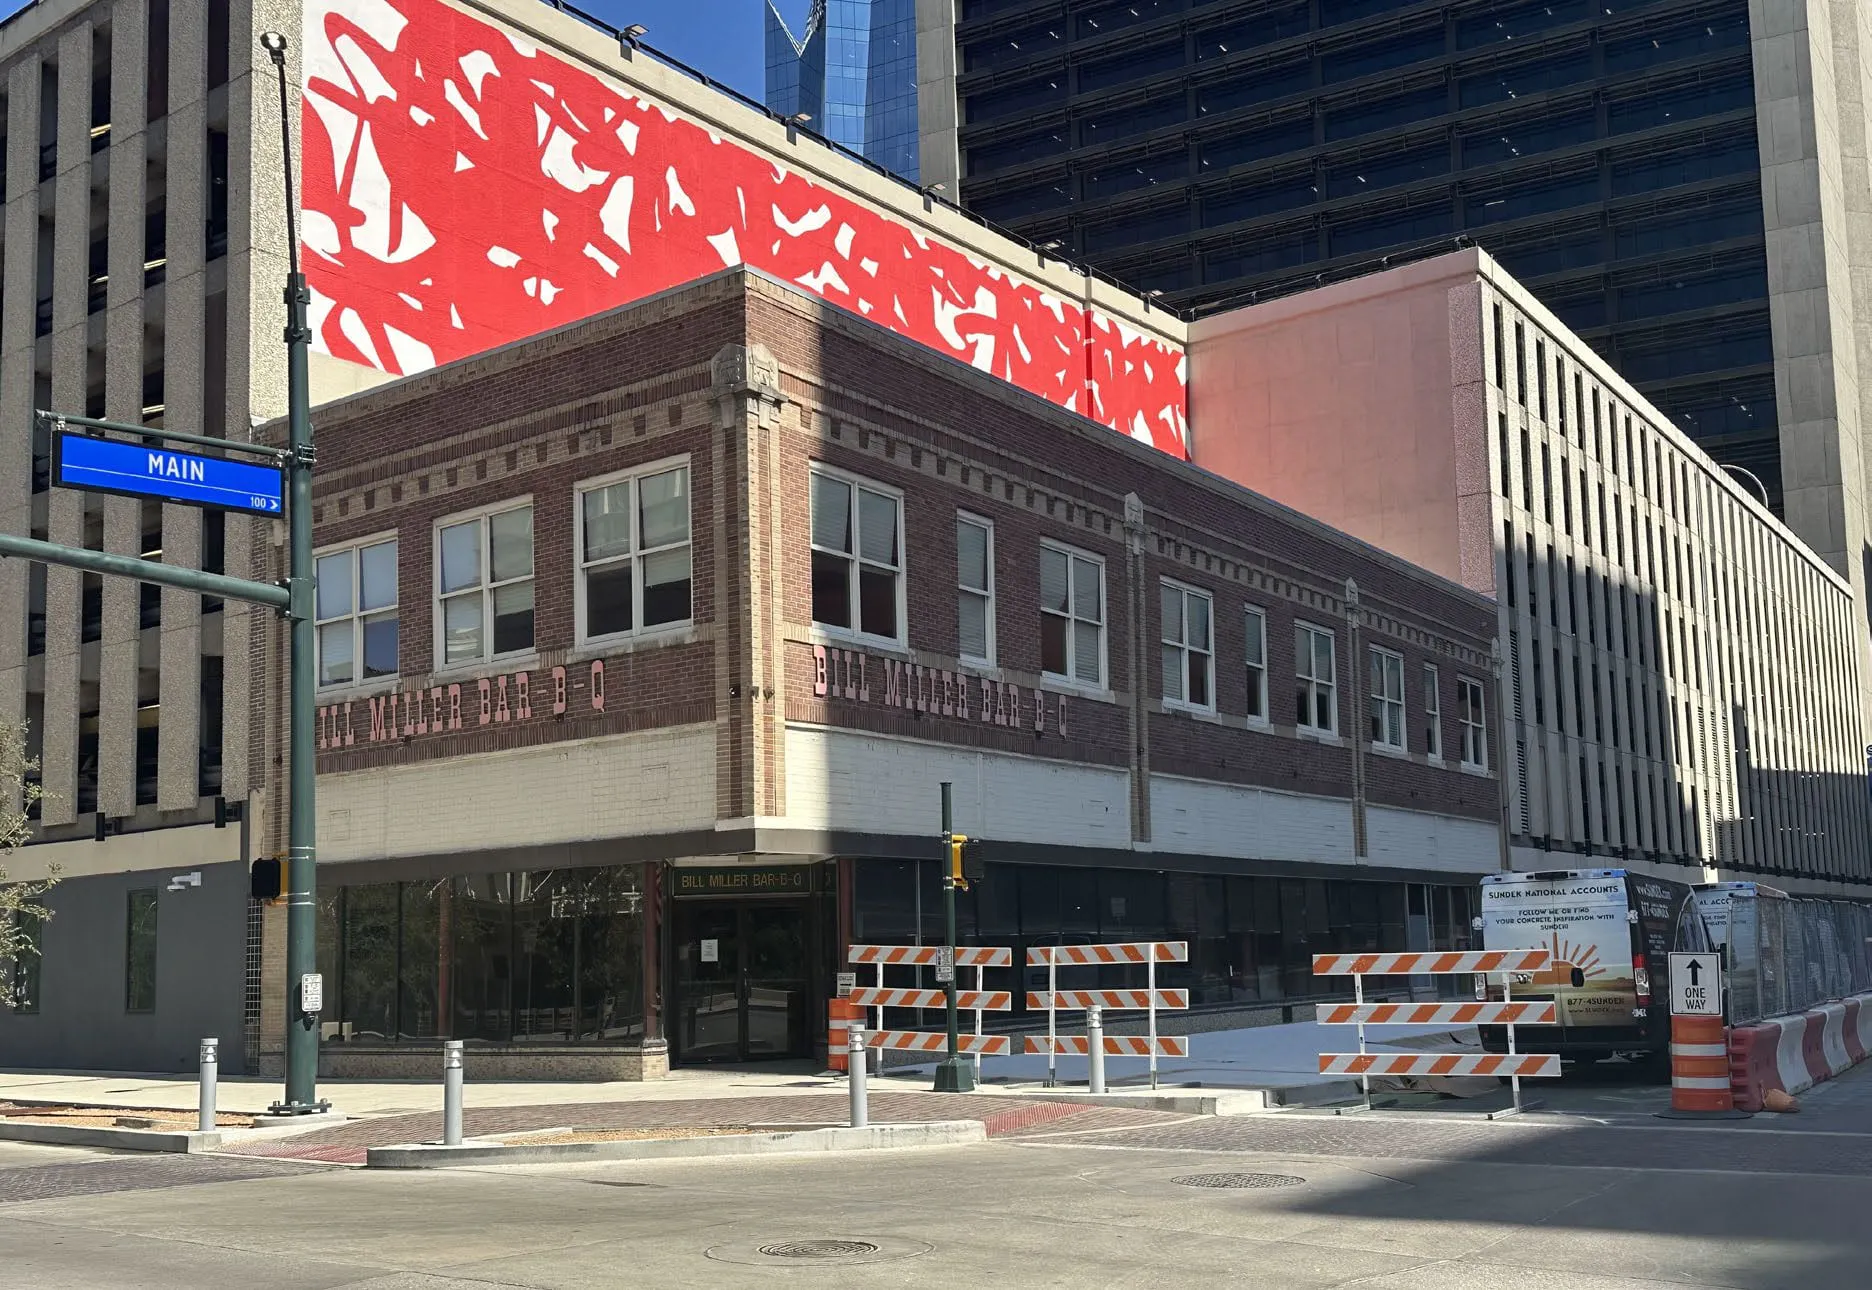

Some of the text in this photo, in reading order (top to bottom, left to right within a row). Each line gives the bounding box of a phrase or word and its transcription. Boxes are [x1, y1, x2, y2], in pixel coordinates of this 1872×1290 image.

[148, 453, 205, 482] MAIN
[250, 496, 266, 509] 100
[812, 644, 1068, 739] BILL MILLER BAR-B-Q
[319, 659, 606, 749] ILL MILLER BAR-B-Q
[681, 873, 802, 888] BILL MILLER BAR-B-Q
[1488, 885, 1619, 899] SUNDEK NATIONAL ACCOUNTS
[1516, 916, 1552, 924] CONCRETE
[1684, 987, 1706, 998] ONE
[1685, 1000, 1706, 1010] WAY
